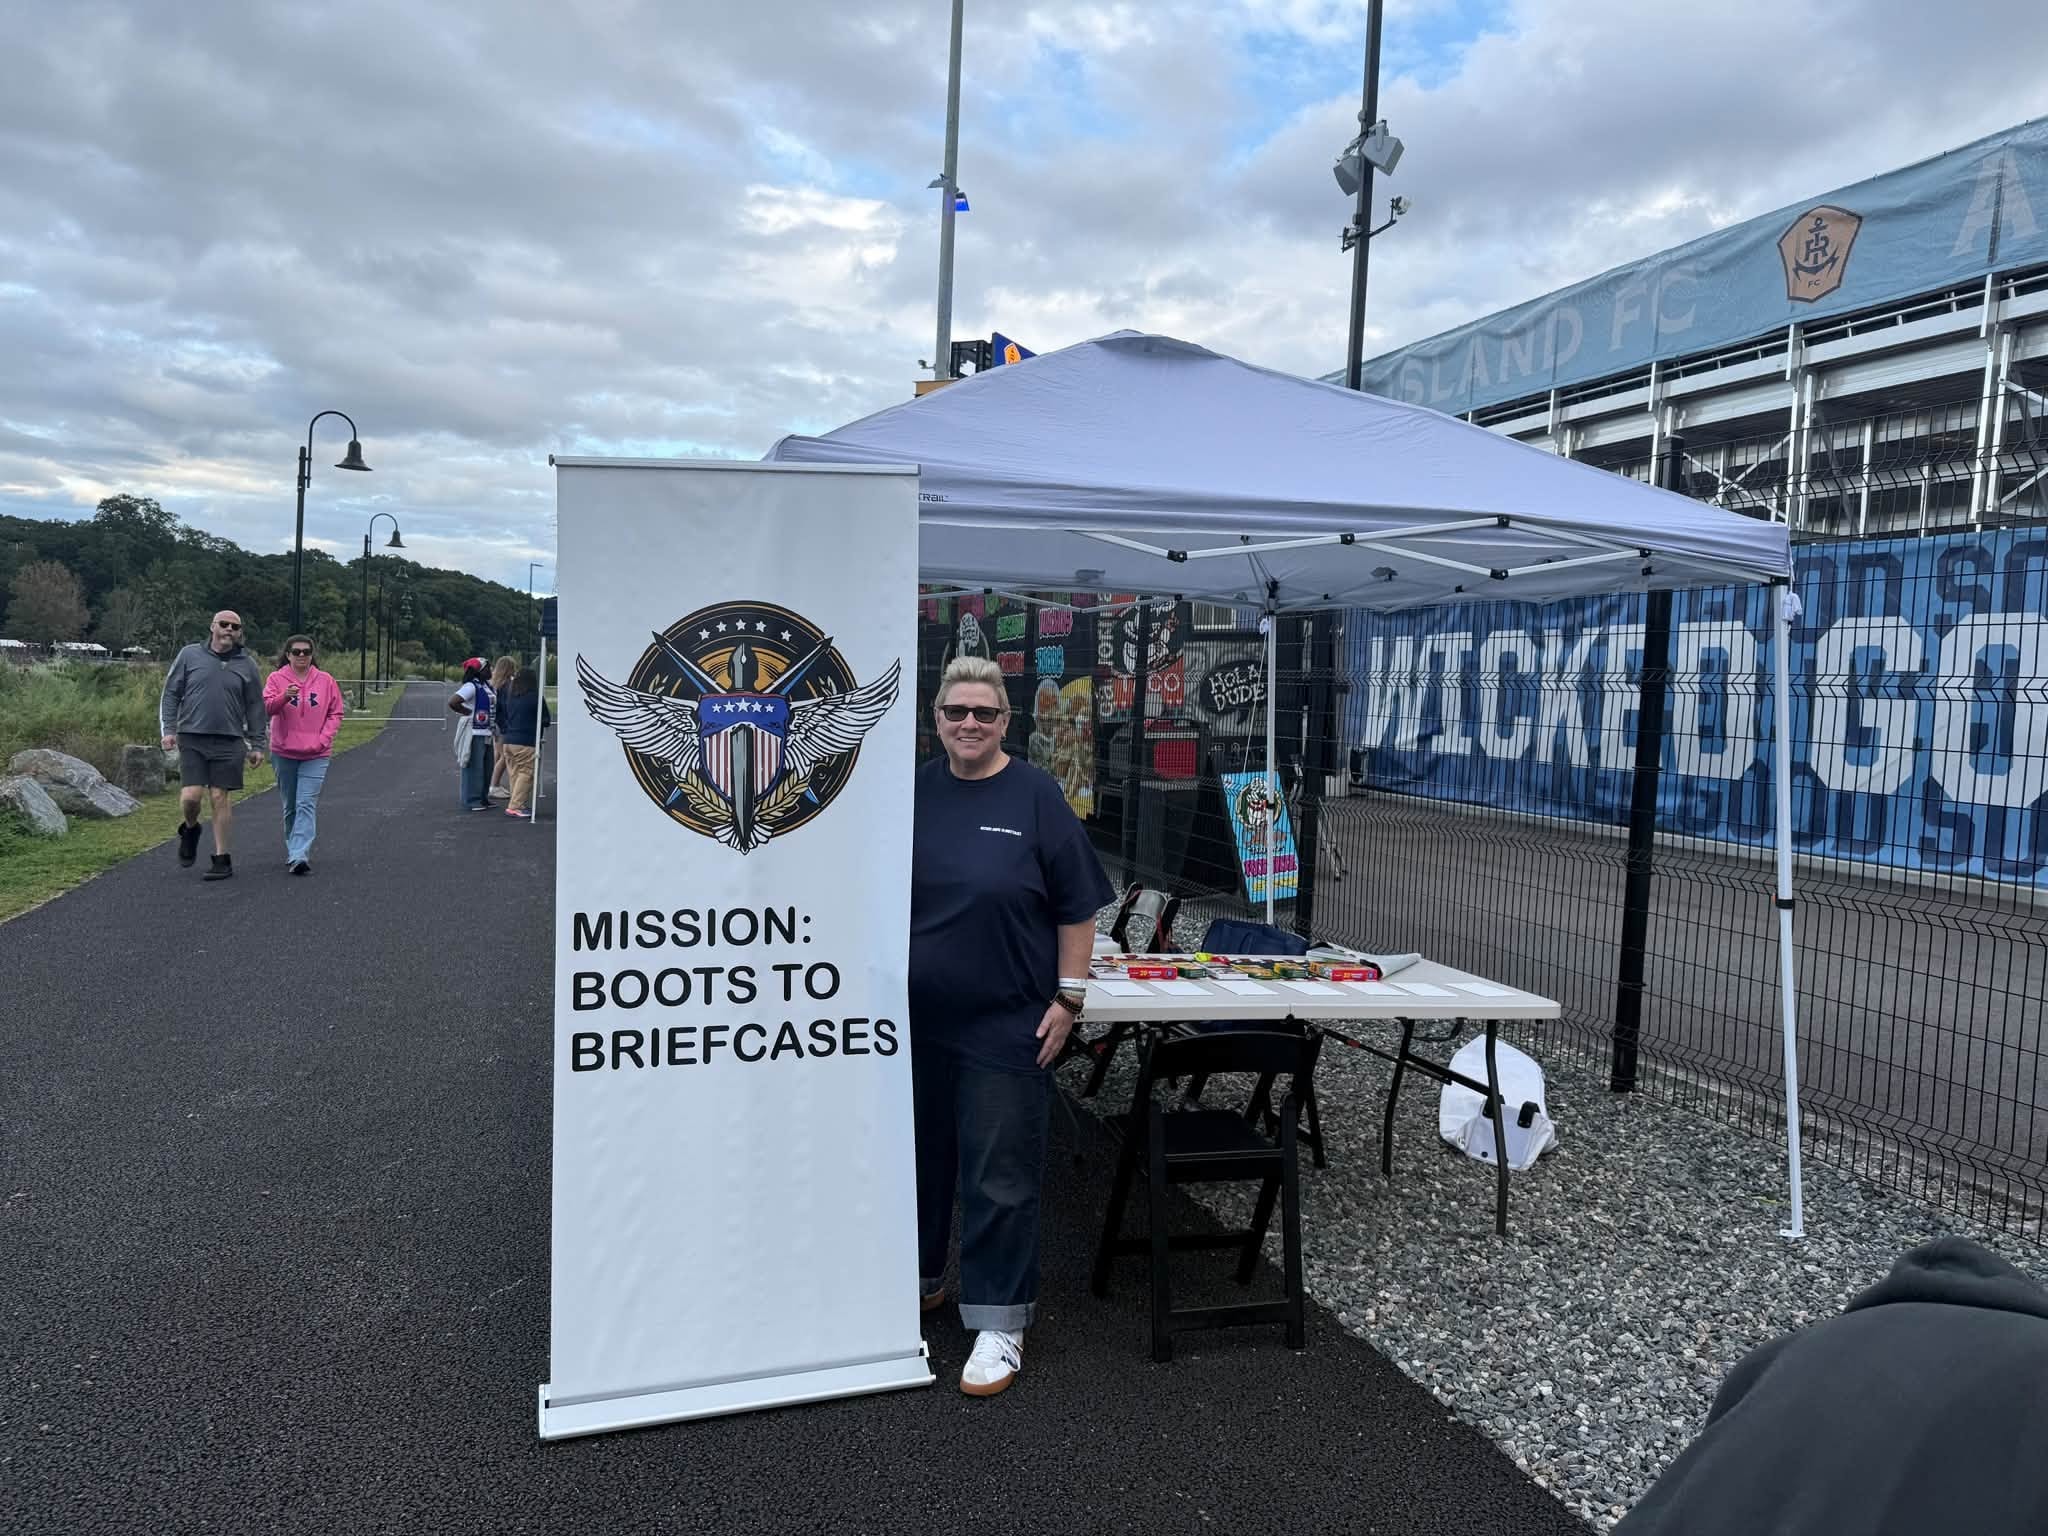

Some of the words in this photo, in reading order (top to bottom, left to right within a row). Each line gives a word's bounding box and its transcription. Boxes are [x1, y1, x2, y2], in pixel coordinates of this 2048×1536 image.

[1609, 264, 1696, 352] FC
[1807, 279, 1822, 289] FC
[1214, 683, 1266, 712] DUDE
[1361, 621, 1757, 781] WICKED
[572, 905, 812, 952] MISSION:
[571, 965, 758, 1012] BOOTS
[771, 961, 841, 1002] TO
[571, 1017, 900, 1073] BRIEFCASES
